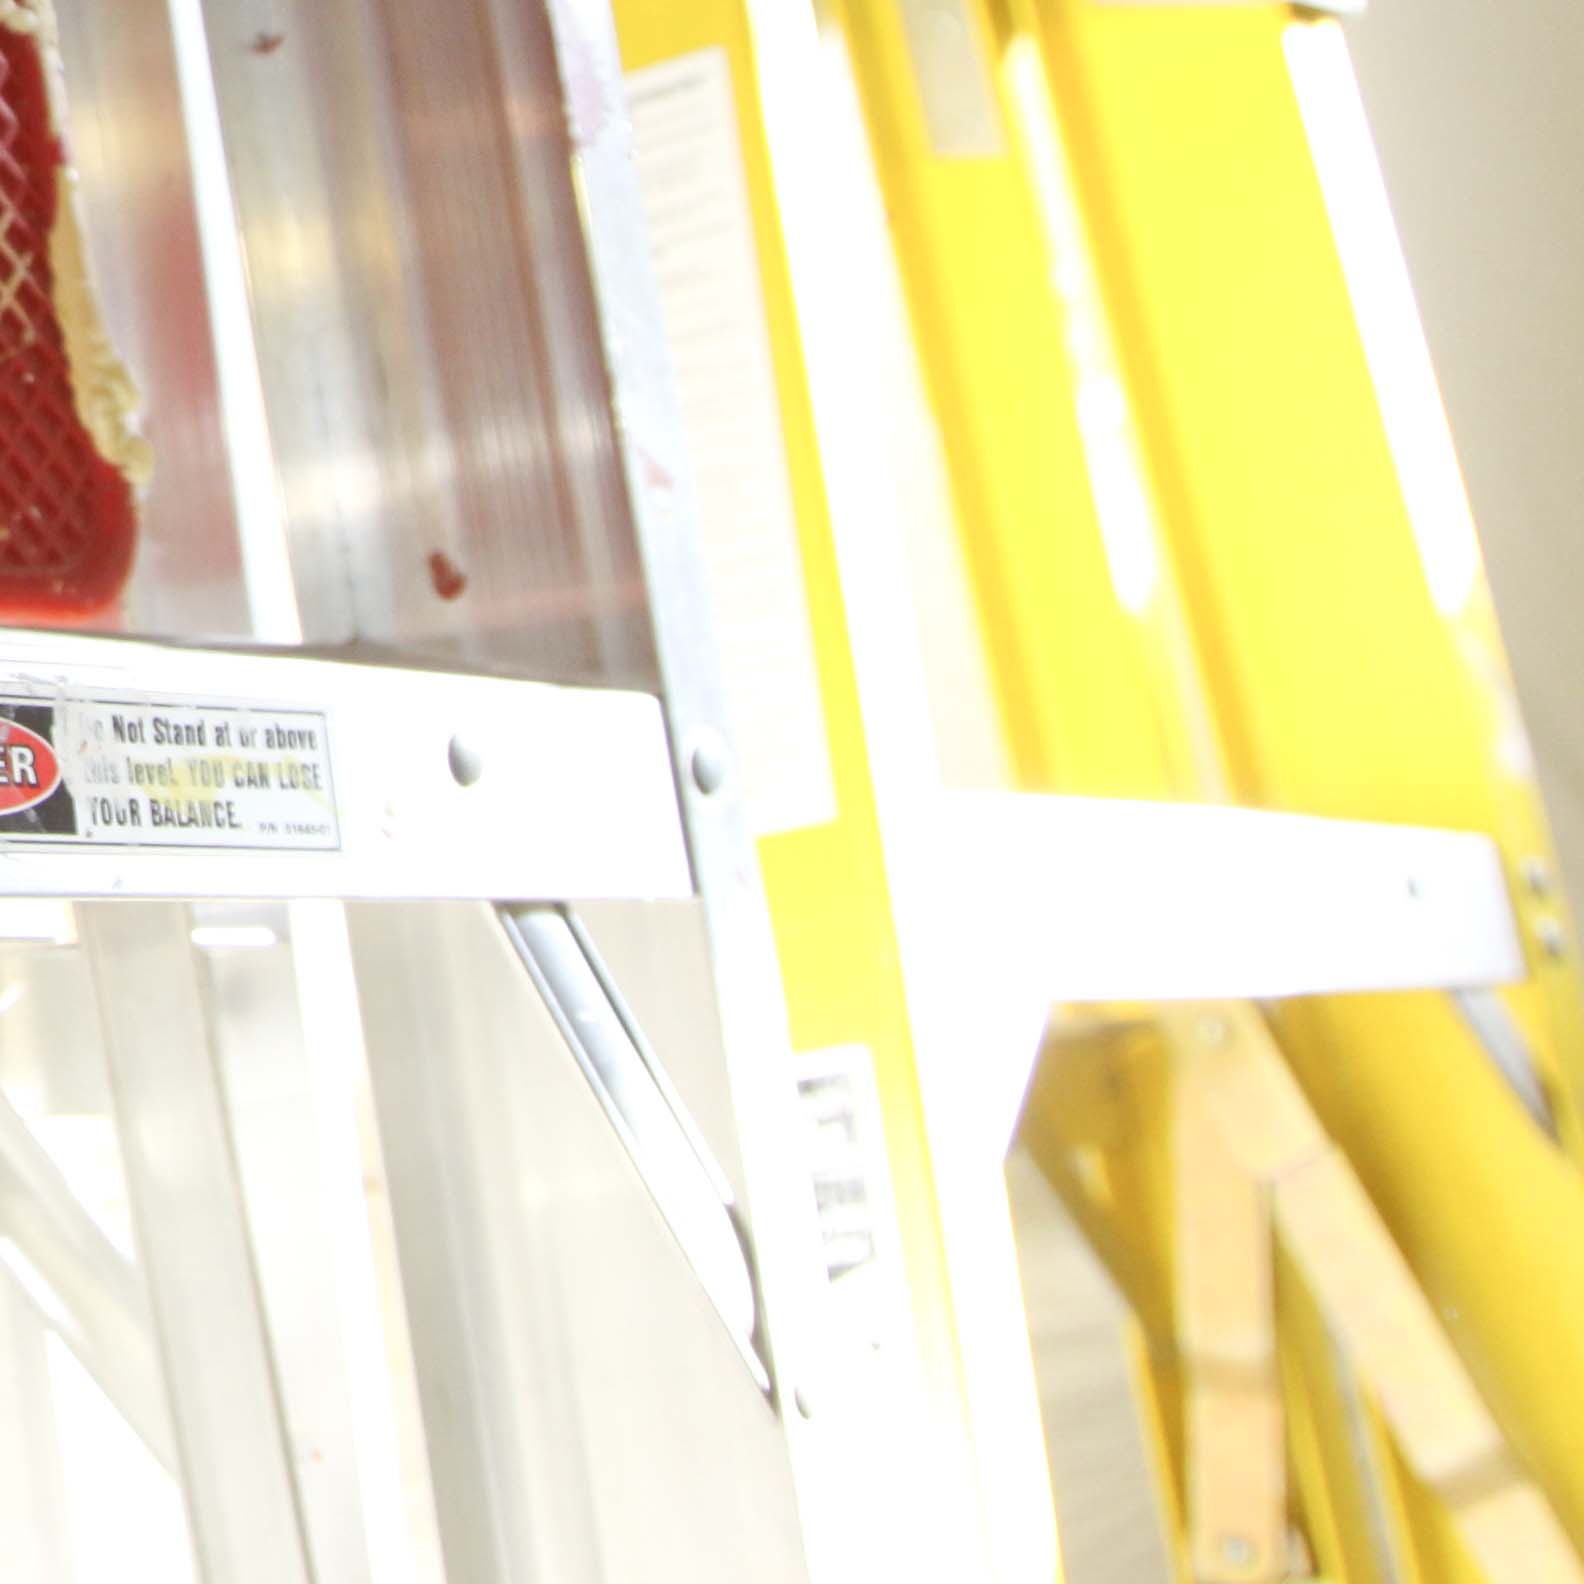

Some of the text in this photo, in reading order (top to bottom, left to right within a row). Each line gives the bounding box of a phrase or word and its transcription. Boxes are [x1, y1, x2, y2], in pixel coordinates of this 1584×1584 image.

[112, 714, 145, 744] Not
[152, 717, 206, 747] Stand
[214, 722, 232, 747] at
[265, 723, 318, 750] above
[189, 760, 225, 787] YOU
[233, 763, 271, 789] CAN
[278, 763, 322, 790] LOSE
